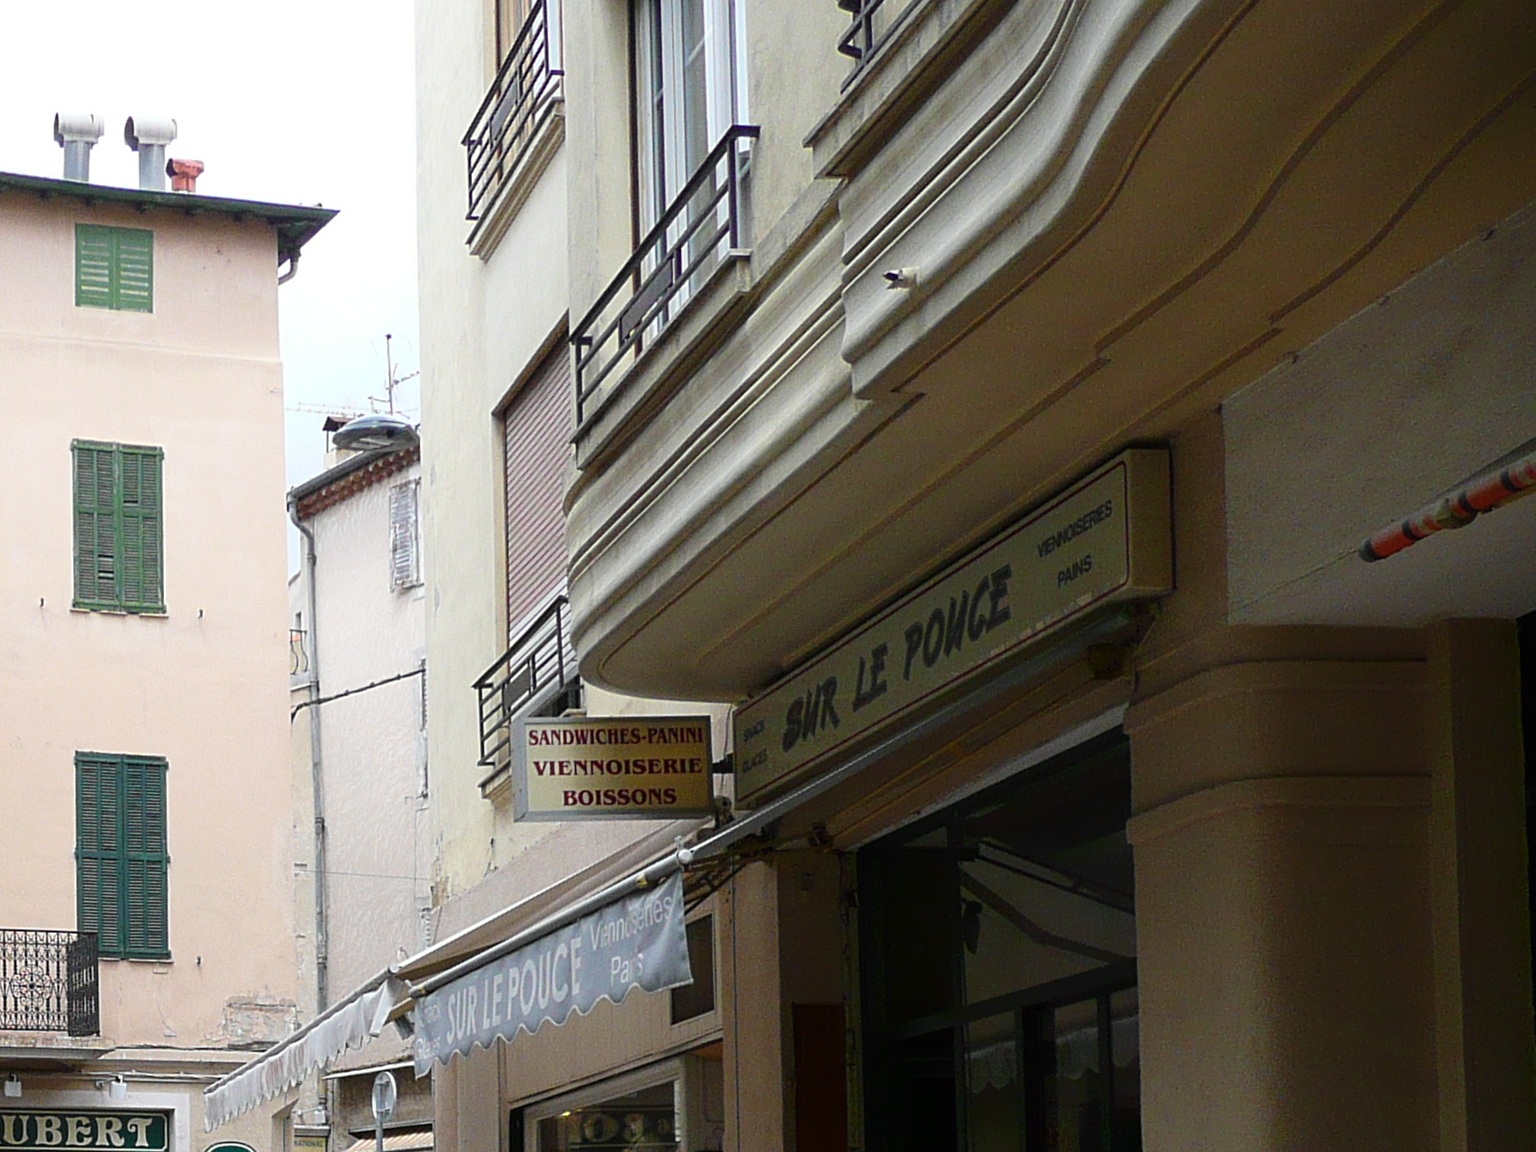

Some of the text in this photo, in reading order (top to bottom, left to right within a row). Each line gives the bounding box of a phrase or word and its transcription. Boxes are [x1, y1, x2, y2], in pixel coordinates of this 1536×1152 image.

[1037, 499, 1113, 558] VIENNOISERIES
[1057, 554, 1093, 588] PAINS
[781, 562, 1013, 753] SUR LE POUCE
[528, 727, 705, 746] SANDWICHES-PANINI
[532, 758, 704, 776] VIENNOISERIE
[562, 788, 678, 806] BOISSONS
[446, 936, 582, 1045] SUR LE POUCE
